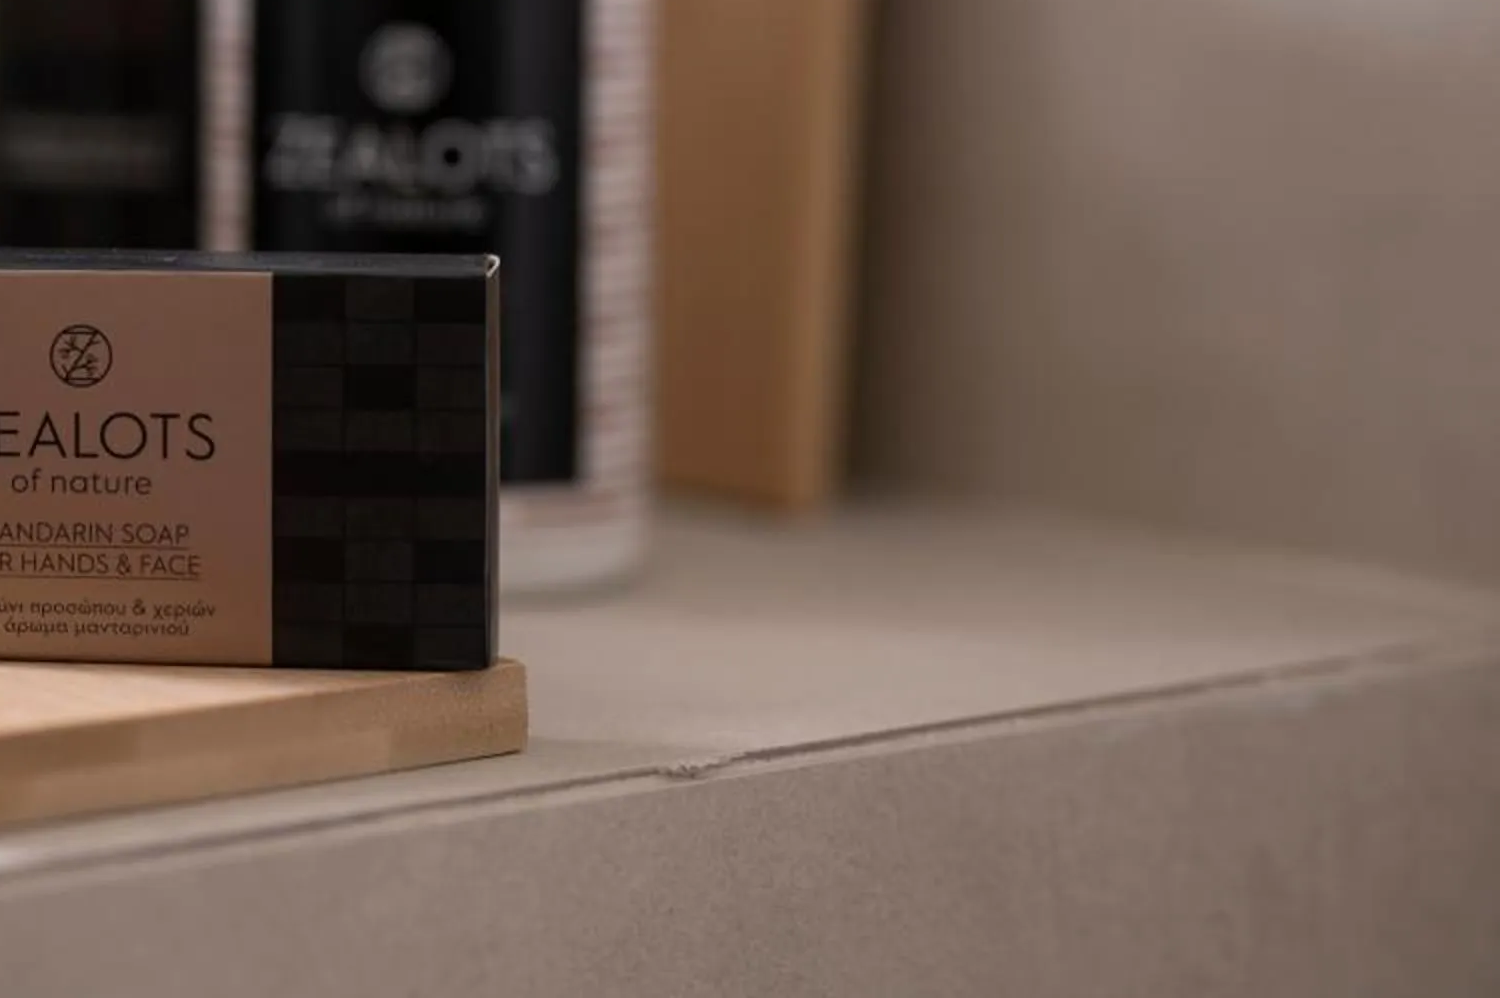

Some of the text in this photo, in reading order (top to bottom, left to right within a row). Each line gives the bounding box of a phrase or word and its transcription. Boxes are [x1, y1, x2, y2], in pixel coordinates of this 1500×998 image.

[10, 466, 153, 496] of nature
[121, 523, 190, 546] SOAP
[19, 552, 109, 575] HANDS
[115, 553, 132, 577] &
[139, 554, 203, 577] FACE
[30, 597, 127, 619] προσώπου
[132, 598, 147, 617] &
[152, 598, 217, 621] χεριών
[3, 616, 70, 638] άρωμα
[74, 618, 191, 640] μανταρινιού
